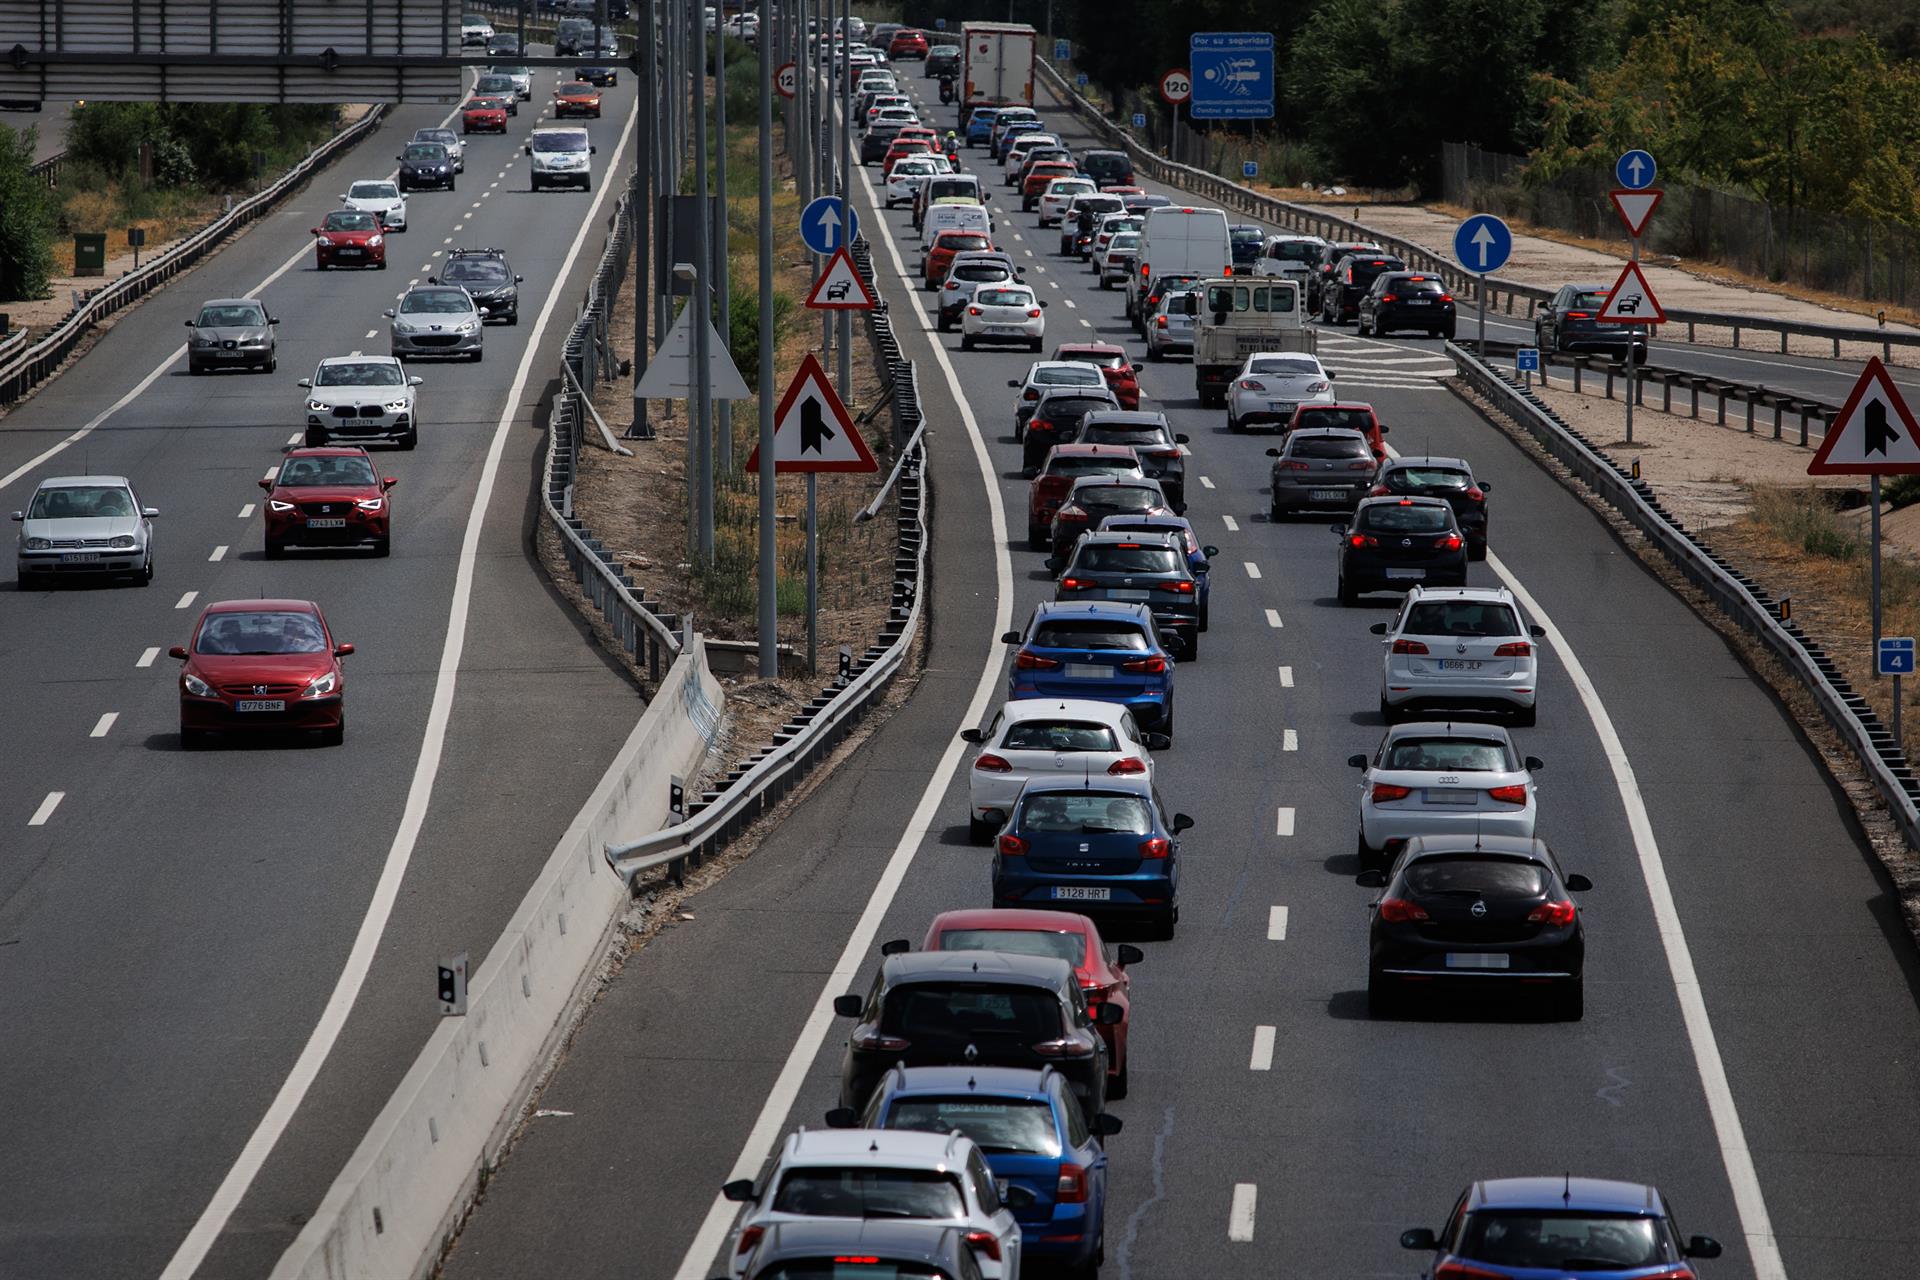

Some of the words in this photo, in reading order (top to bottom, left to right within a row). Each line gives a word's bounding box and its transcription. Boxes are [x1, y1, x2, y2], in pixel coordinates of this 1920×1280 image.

[1229, 37, 1269, 45] seguridad
[1165, 81, 1189, 93] 120
[1525, 359, 1532, 367] 5
[1890, 655, 1903, 668] 4
[241, 701, 264, 710] 9776
[265, 701, 282, 710] BNF
[1060, 888, 1084, 898] 3128
[1088, 889, 1106, 899] HRT
